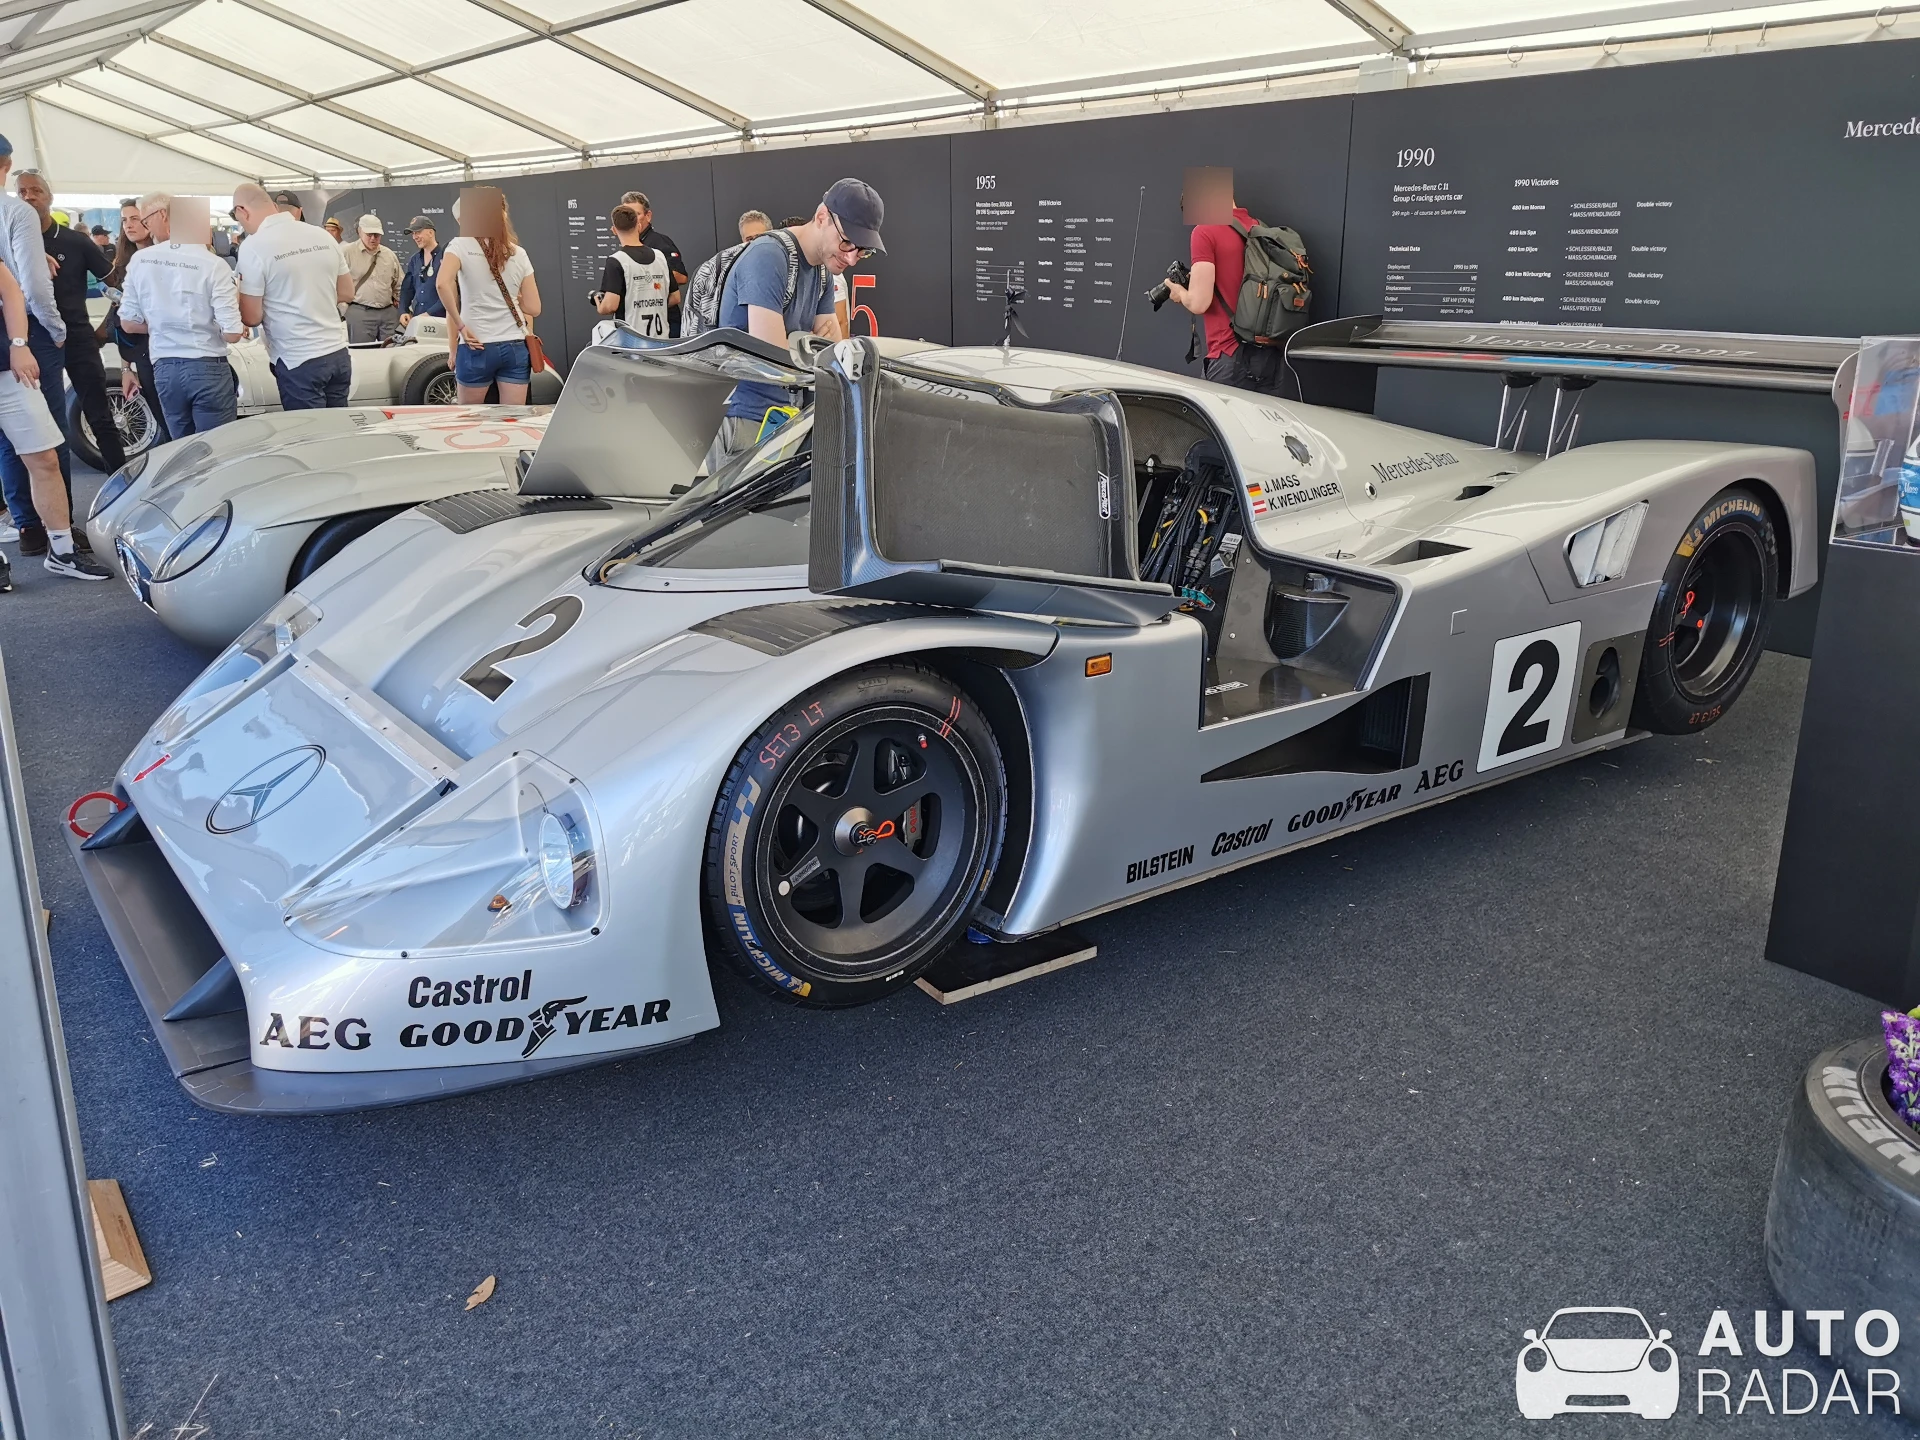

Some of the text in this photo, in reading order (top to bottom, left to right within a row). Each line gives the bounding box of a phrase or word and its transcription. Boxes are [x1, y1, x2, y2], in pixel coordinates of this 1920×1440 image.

[1396, 147, 1435, 168] 1990
[975, 175, 996, 190] 1955
[1393, 183, 1437, 192] Mercedes-Benz
[1437, 182, 1443, 191] C
[1514, 178, 1559, 187] 1990 Victories
[1393, 193, 1464, 203] Group C racing sports car
[1655, 200, 1673, 208] victory
[274, 244, 331, 261] Mercedes-Benz Classic
[1649, 245, 1667, 253] victory
[140, 258, 200, 270] Mercedes-Benz Classic
[423, 325, 436, 333] 322
[641, 313, 663, 336] 70
[1370, 452, 1460, 484] Mercedes-Benz
[1703, 499, 1762, 531] MICHELIN
[456, 594, 585, 705] 2
[1496, 639, 1560, 758] 2
[1126, 845, 1195, 884] BILSTEIN
[1211, 818, 1274, 857] Castrol
[1413, 759, 1464, 795] AEG
[729, 832, 739, 898] PILOT SPORT
[733, 912, 788, 982] MICHELIN
[408, 969, 533, 1009] Castrol
[259, 1012, 372, 1051] AEG
[1822, 1066, 1920, 1176] HELIN
